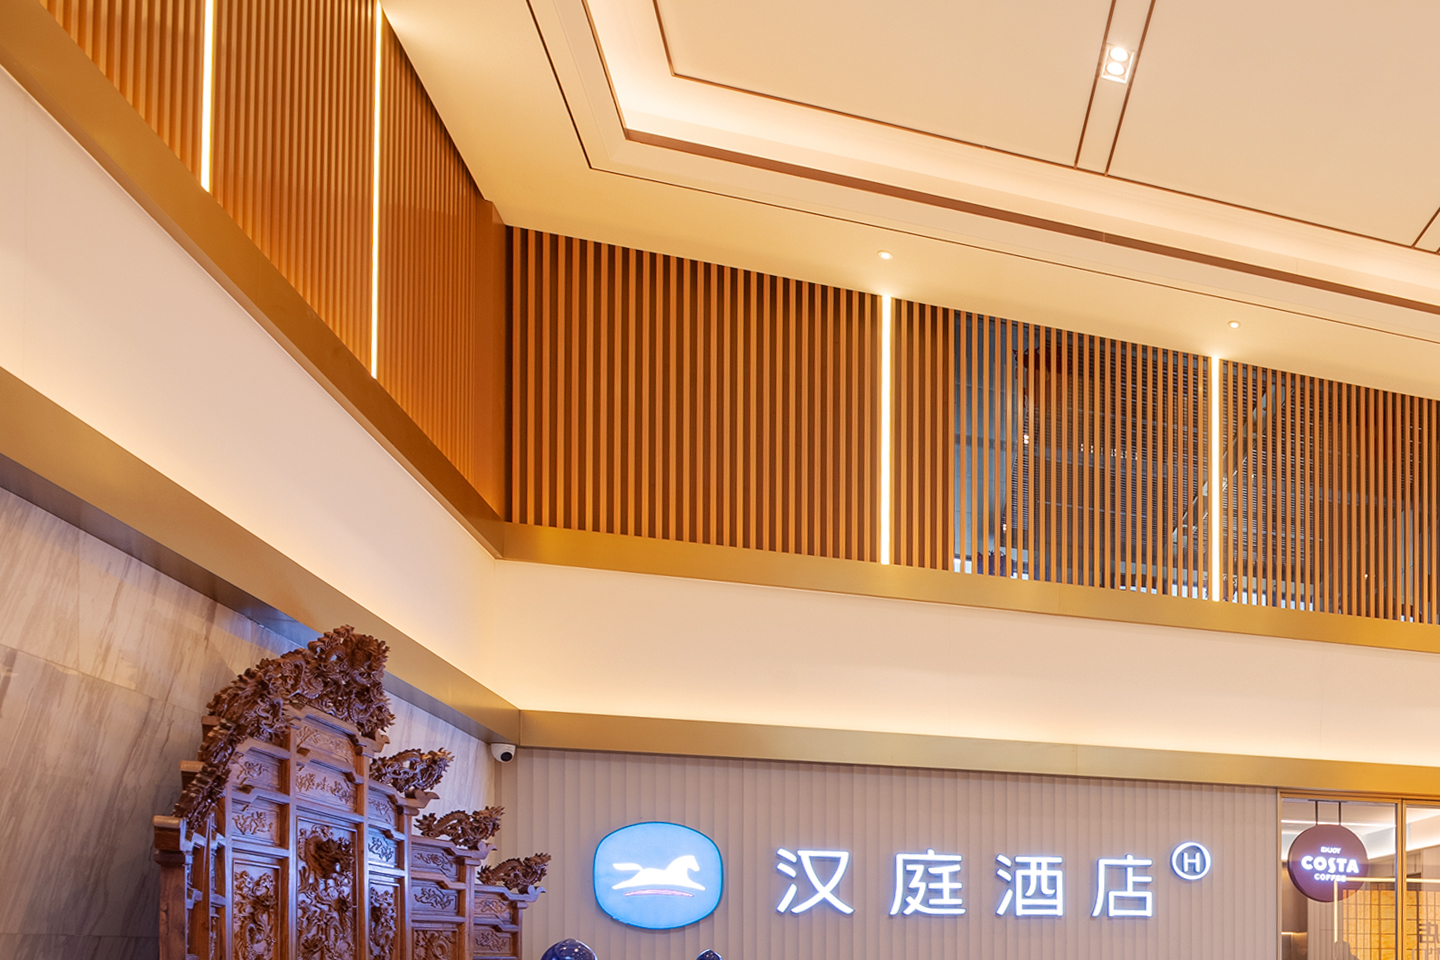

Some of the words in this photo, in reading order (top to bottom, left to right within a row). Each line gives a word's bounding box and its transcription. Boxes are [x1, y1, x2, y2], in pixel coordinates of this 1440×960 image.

[1301, 855, 1360, 874] COSTA
[775, 847, 1154, 918] 汉庭酒店
[1314, 873, 1347, 882] COFFEE
